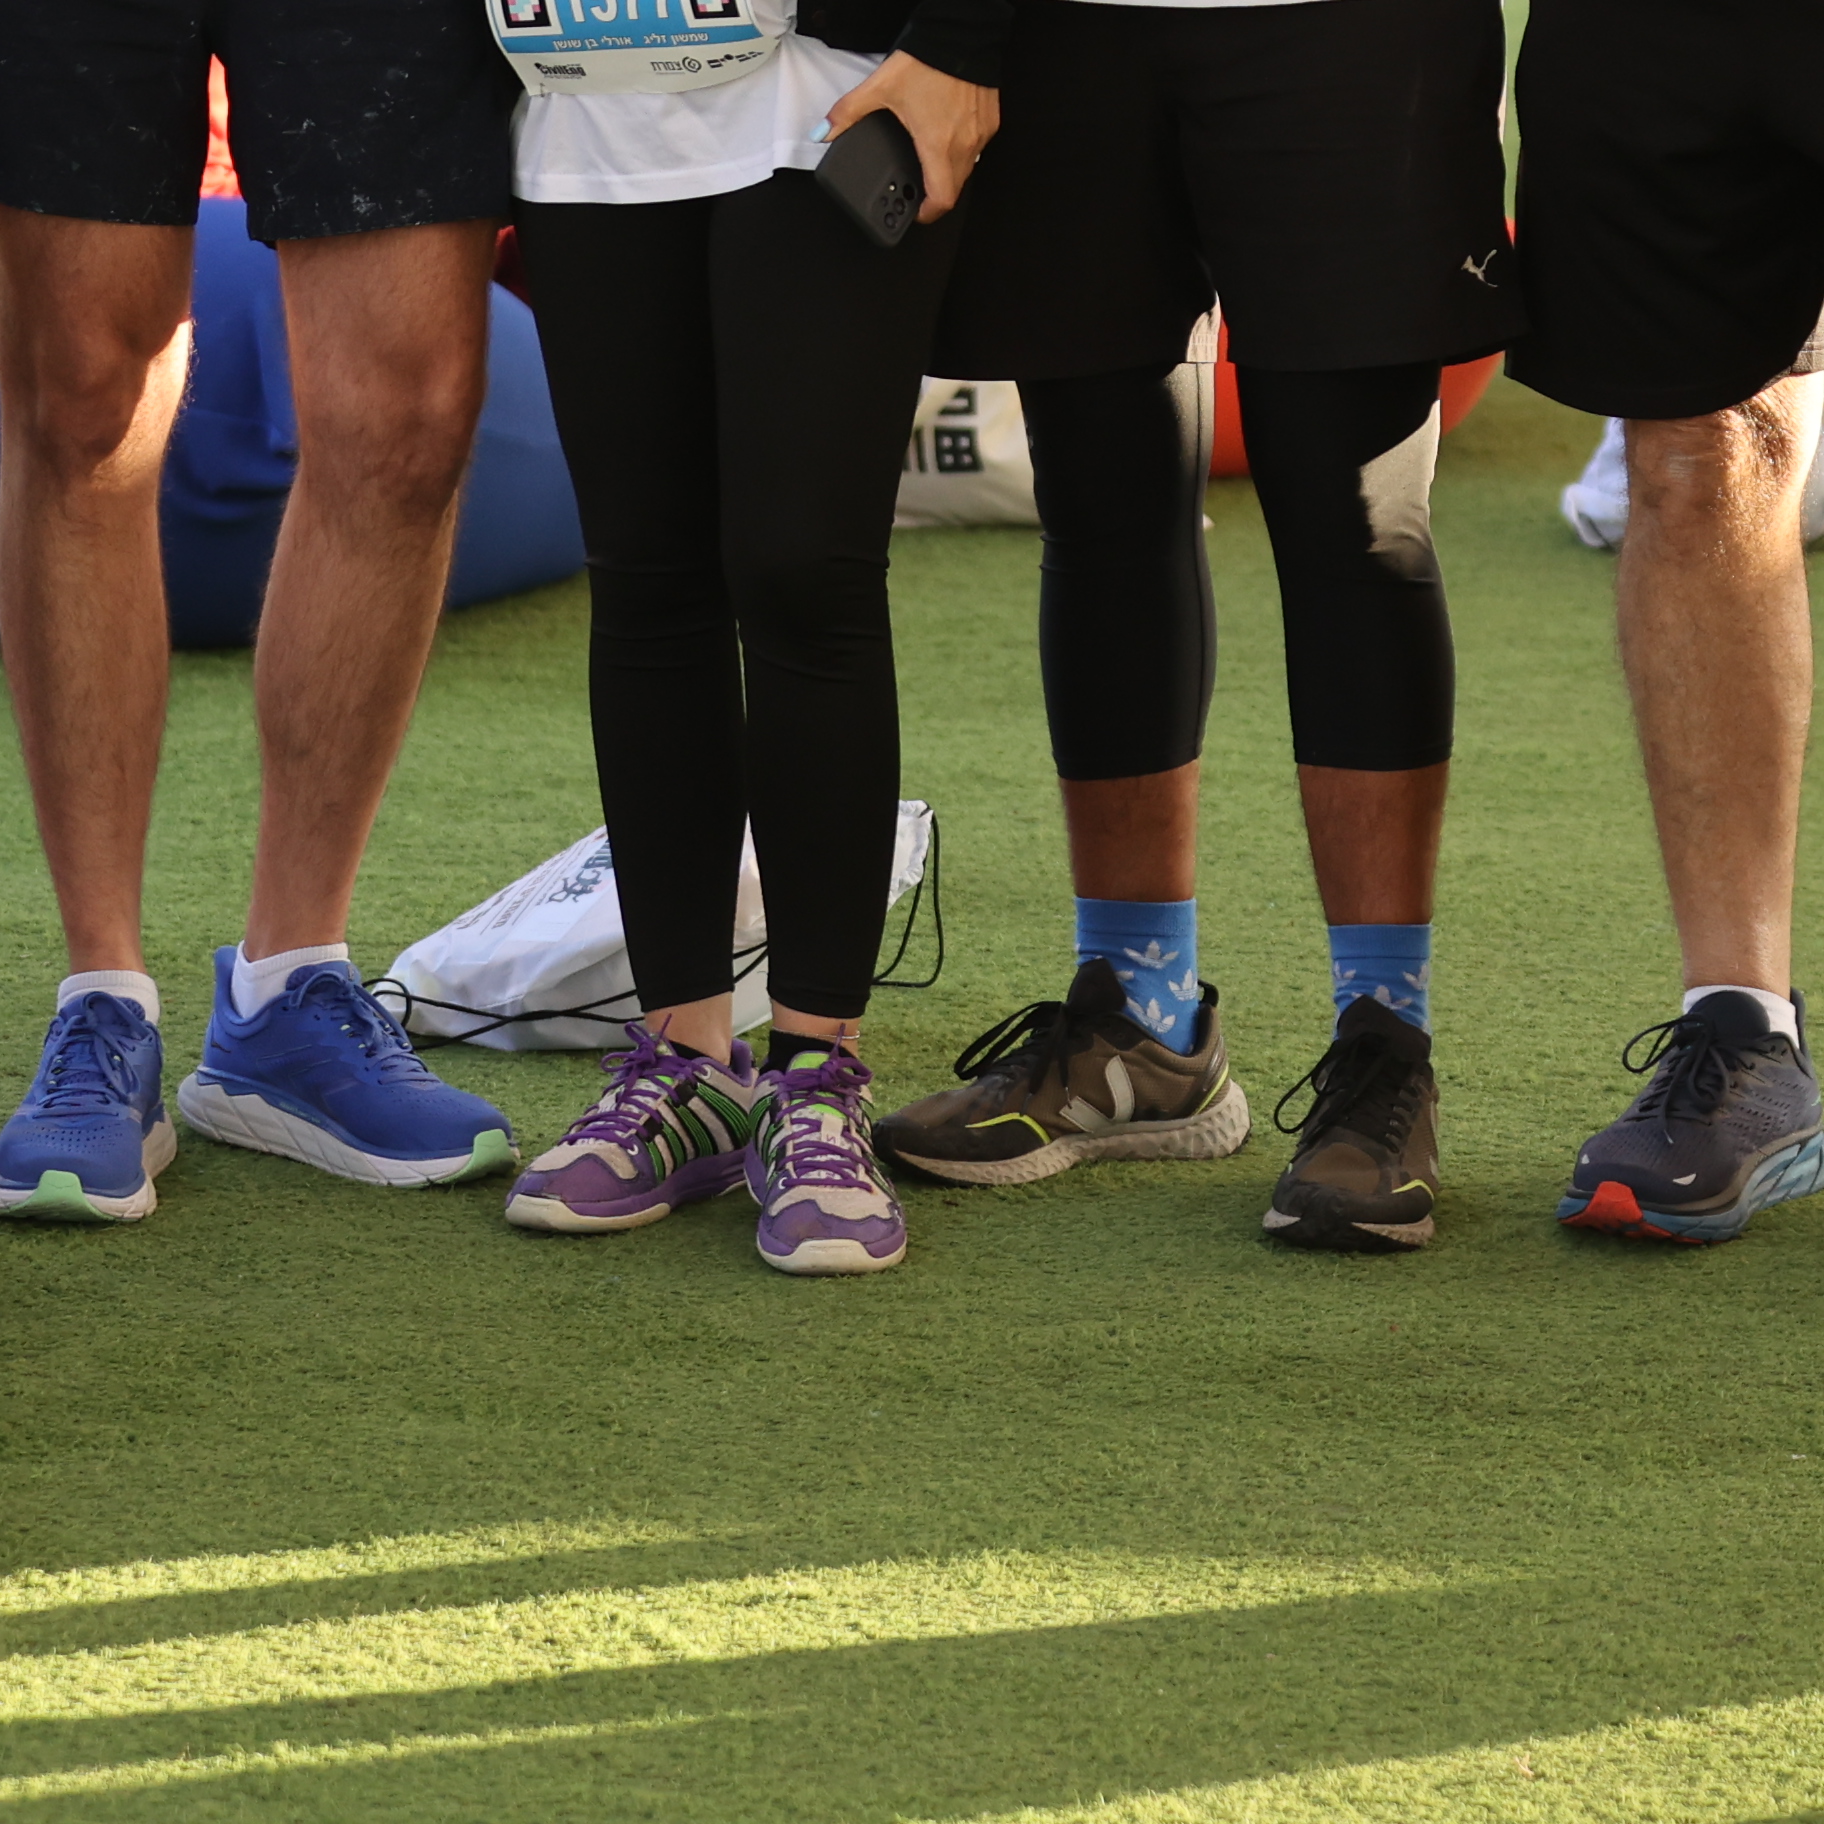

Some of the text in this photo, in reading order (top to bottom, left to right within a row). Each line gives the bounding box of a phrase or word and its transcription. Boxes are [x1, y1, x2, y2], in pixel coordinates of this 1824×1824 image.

[552, 38, 582, 52] שושן
[597, 34, 633, 46] אורלי
[643, 34, 668, 46] זליג
[670, 31, 709, 46] שמשון
